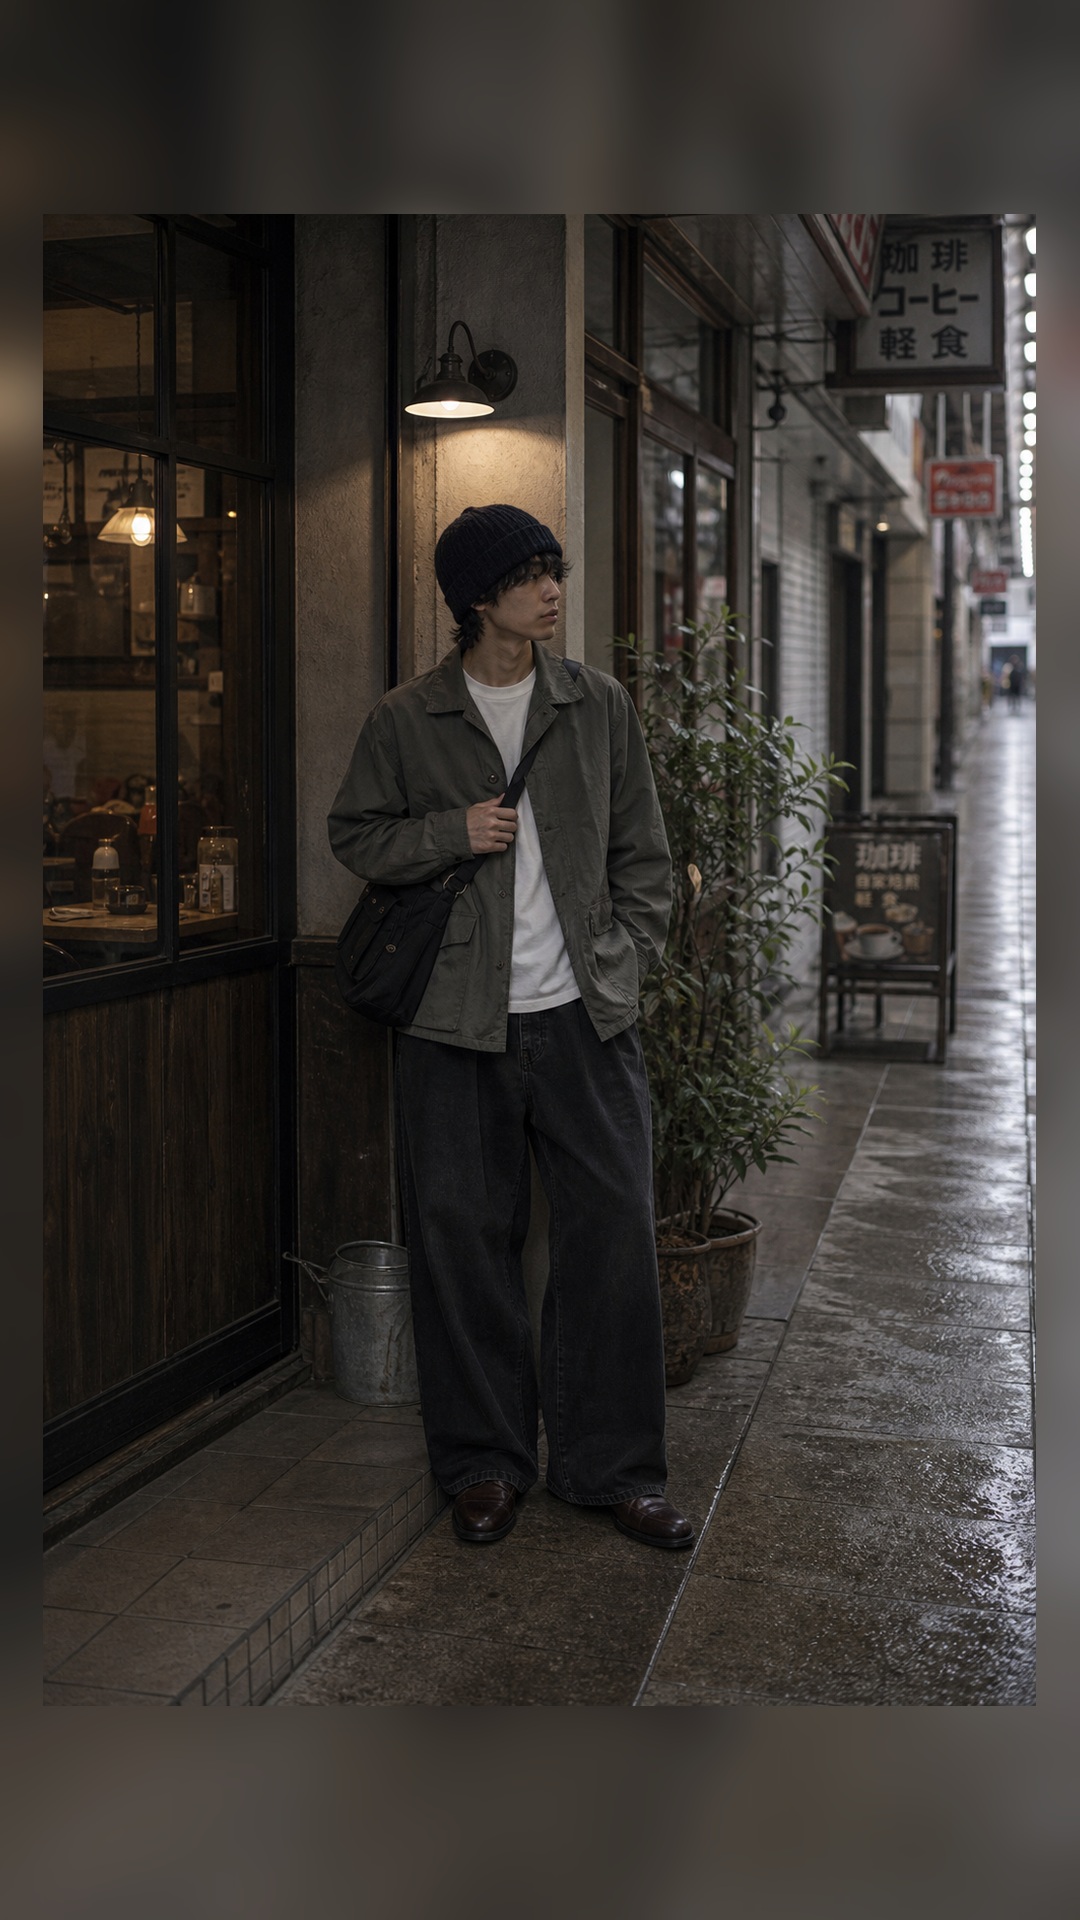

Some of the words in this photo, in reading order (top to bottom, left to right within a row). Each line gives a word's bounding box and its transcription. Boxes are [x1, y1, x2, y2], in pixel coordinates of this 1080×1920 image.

[882, 239, 968, 275] 珈琲
[879, 283, 979, 317] コーヒー
[880, 325, 969, 361] 軽食
[855, 841, 922, 871] 珈琲
